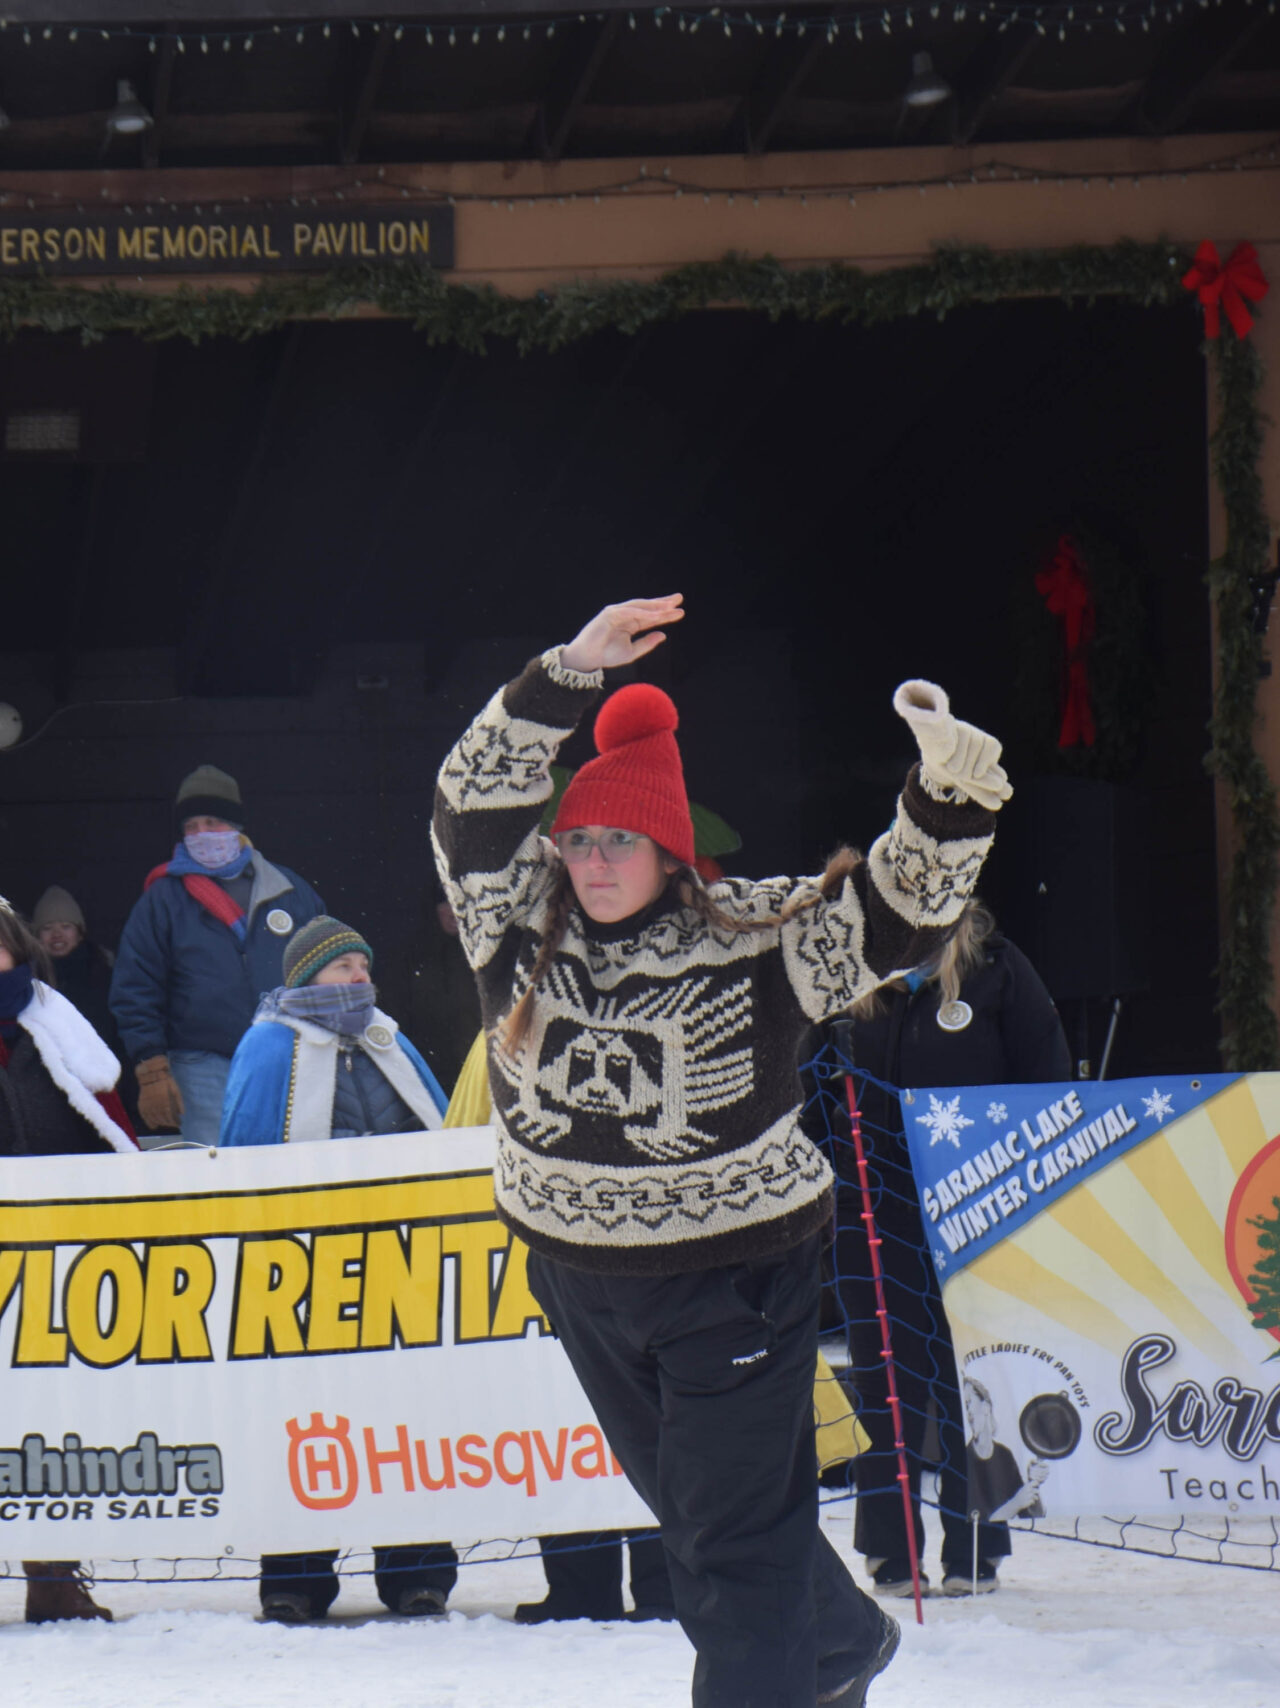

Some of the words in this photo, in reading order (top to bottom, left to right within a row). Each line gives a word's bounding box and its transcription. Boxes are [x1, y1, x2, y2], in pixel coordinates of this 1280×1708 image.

[119, 225, 281, 260] MEMORIAL
[294, 220, 430, 256] PAVILION
[923, 1131, 1025, 1223] SARANAC
[1021, 1090, 1084, 1150] LAKE
[938, 1176, 1028, 1254] WINTER
[1026, 1104, 1137, 1193] CARNIVAL
[991, 1342, 1030, 1354] LADIES
[1032, 1348, 1054, 1364] FRY
[1054, 1361, 1074, 1381] PAN
[1072, 1381, 1091, 1408] TOSS
[107, 1497, 220, 1520] SALES
